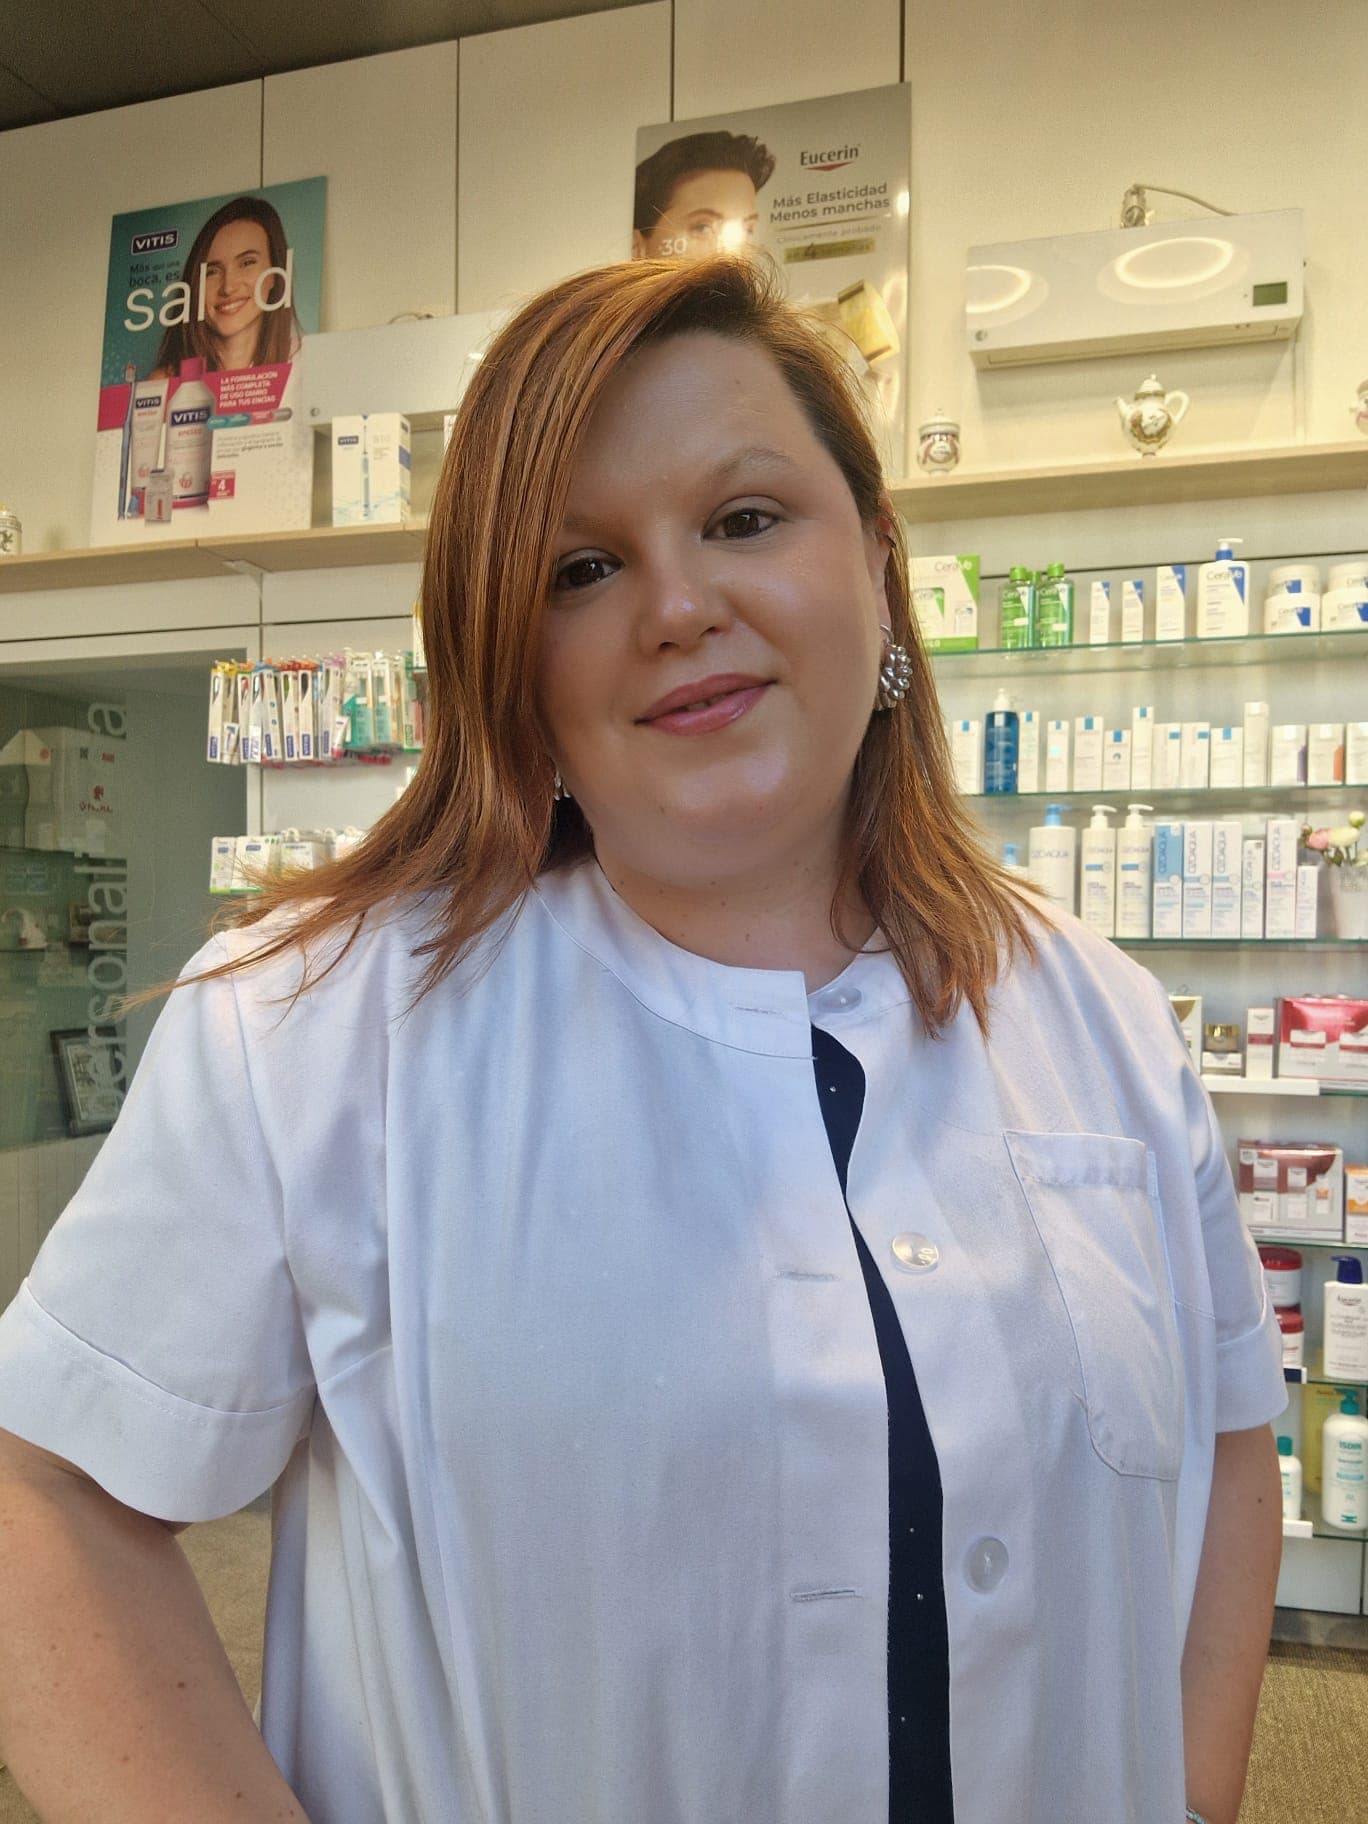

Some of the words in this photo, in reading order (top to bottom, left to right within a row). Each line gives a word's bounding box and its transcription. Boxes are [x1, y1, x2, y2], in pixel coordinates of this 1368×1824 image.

[800, 145, 858, 166] Eucerin
[773, 196, 802, 208] Más
[807, 183, 887, 204] Elasticidad
[769, 208, 818, 223] Menos
[822, 197, 890, 216] manchas
[135, 234, 175, 250] VITIS
[136, 399, 160, 407] VITIS
[172, 411, 208, 424] VITIS
